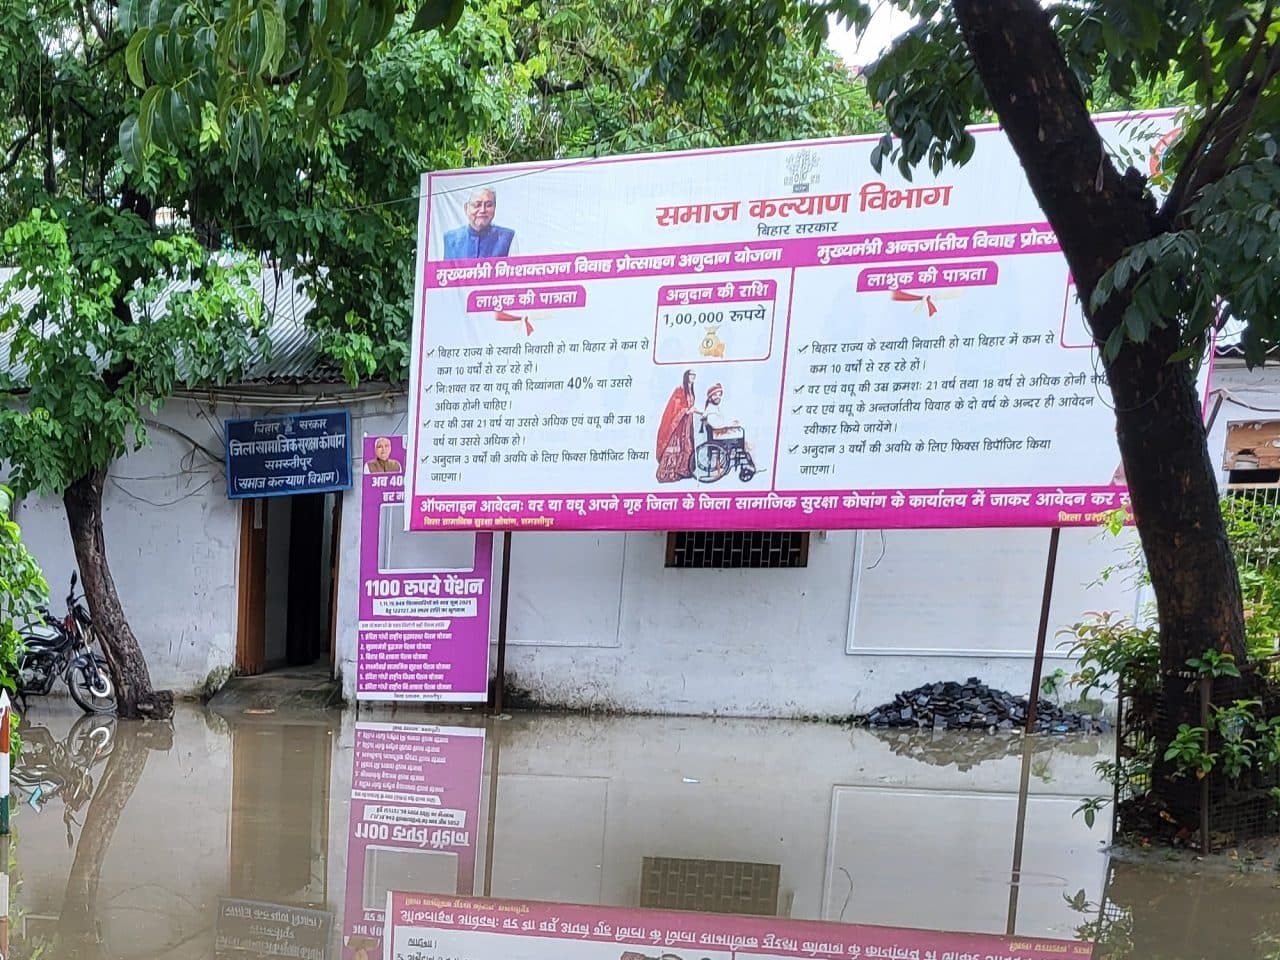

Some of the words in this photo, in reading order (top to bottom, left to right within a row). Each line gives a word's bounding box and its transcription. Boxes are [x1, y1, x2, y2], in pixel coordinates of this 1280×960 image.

[655, 200, 740, 227] समाज
[749, 192, 850, 220] कल्याण
[860, 175, 952, 213] विभाग
[756, 220, 790, 237] बिहार
[796, 221, 837, 234] सरकार
[817, 237, 882, 264] मुख्यमंत्री
[885, 231, 968, 254] अन्तर्जातीय
[972, 228, 1015, 250] विवाह
[435, 262, 491, 286] मुख्यमंत्री
[495, 257, 570, 277] निःशक्तजन
[574, 254, 612, 274] विवाह
[616, 251, 674, 272] प्रोत्साहन
[679, 251, 730, 272] अनुदान
[735, 244, 782, 263] योजना
[867, 272, 913, 290] लाभुक
[918, 266, 936, 283] की
[942, 267, 987, 282] पात्रता
[475, 294, 514, 311] लाभुक
[518, 290, 534, 304] की
[539, 291, 577, 304] पात्रता
[666, 287, 712, 305] अनुदान
[717, 281, 734, 297] की
[739, 279, 768, 297] राशि
[254, 421, 280, 434] बिहार
[299, 418, 328, 429] सरकार
[229, 439, 255, 457] जिला
[264, 454, 313, 472] समस्तीपुर
[234, 475, 266, 491] (समाज
[267, 474, 306, 488] कल्याण
[307, 469, 340, 485] विभाग)
[371, 475, 389, 488] अब
[420, 497, 475, 514] ऑफलाइन
[480, 495, 523, 512] आवेदनः
[528, 500, 543, 511] वर
[548, 499, 562, 511] या
[566, 499, 586, 515] वधू
[588, 494, 619, 510] अपने
[623, 499, 642, 514] गृह
[645, 493, 677, 509] जिला
[681, 493, 695, 509] के
[698, 492, 731, 509] जिला
[735, 492, 797, 508] सामाजिक
[801, 496, 838, 513] सुरक्षा
[843, 491, 886, 507] कोषांग
[891, 491, 905, 507] के
[909, 489, 966, 507] कार्यालय
[972, 489, 985, 506] में
[990, 494, 1031, 506] जाकर
[1036, 488, 1086, 506] आवेदन
[1091, 492, 1114, 504] कर
[365, 579, 400, 596] 1100
[403, 575, 442, 596] रुपये
[444, 574, 485, 596] पेंशन
